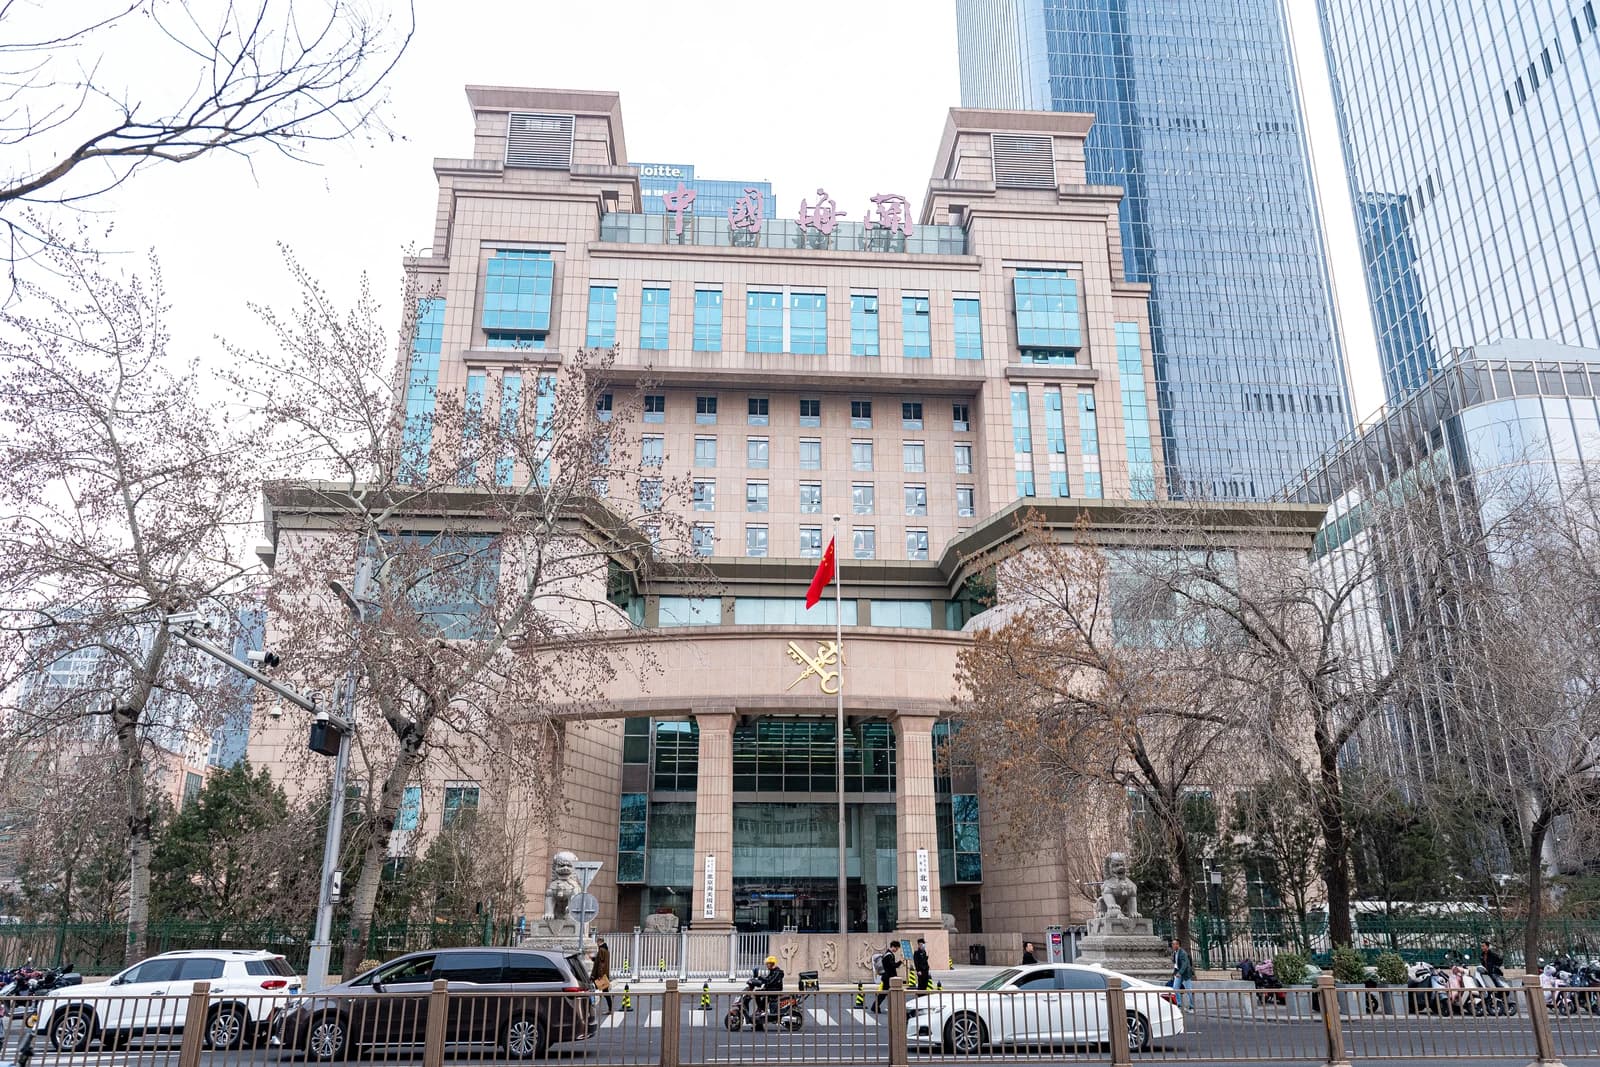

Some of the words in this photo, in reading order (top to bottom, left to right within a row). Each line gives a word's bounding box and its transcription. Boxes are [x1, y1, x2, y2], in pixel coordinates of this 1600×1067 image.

[640, 164, 685, 177] loitte.
[920, 874, 929, 913] 北京海关
